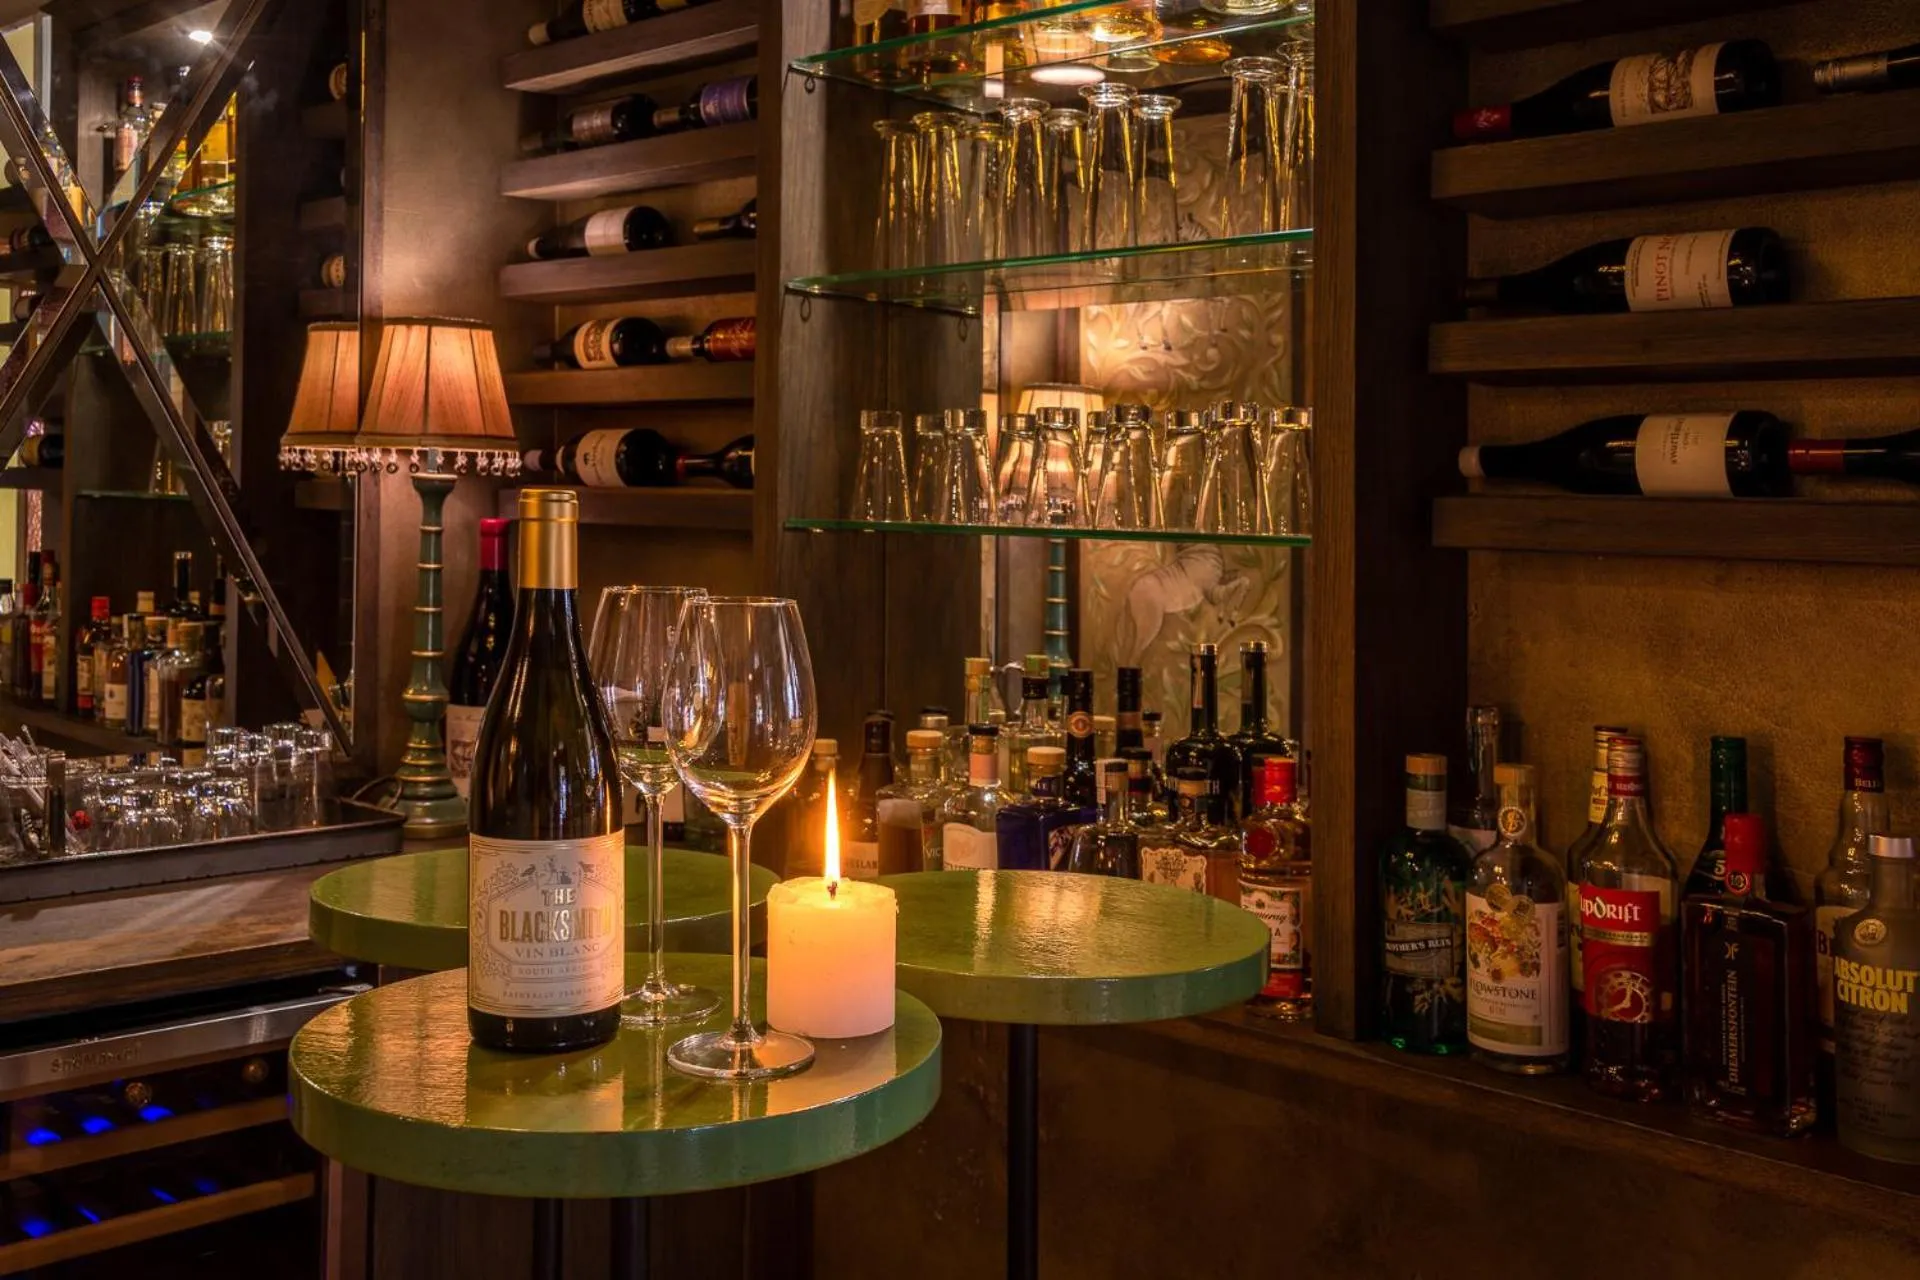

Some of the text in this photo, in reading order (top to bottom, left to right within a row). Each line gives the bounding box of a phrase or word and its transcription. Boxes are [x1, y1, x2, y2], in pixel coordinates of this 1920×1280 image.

[541, 887, 576, 907] THE
[500, 907, 612, 943] BLACKSMITH
[514, 942, 600, 958] VIN BLANC
[1834, 955, 1918, 993] ABSOLUT
[1837, 979, 1909, 1015] CITRON
